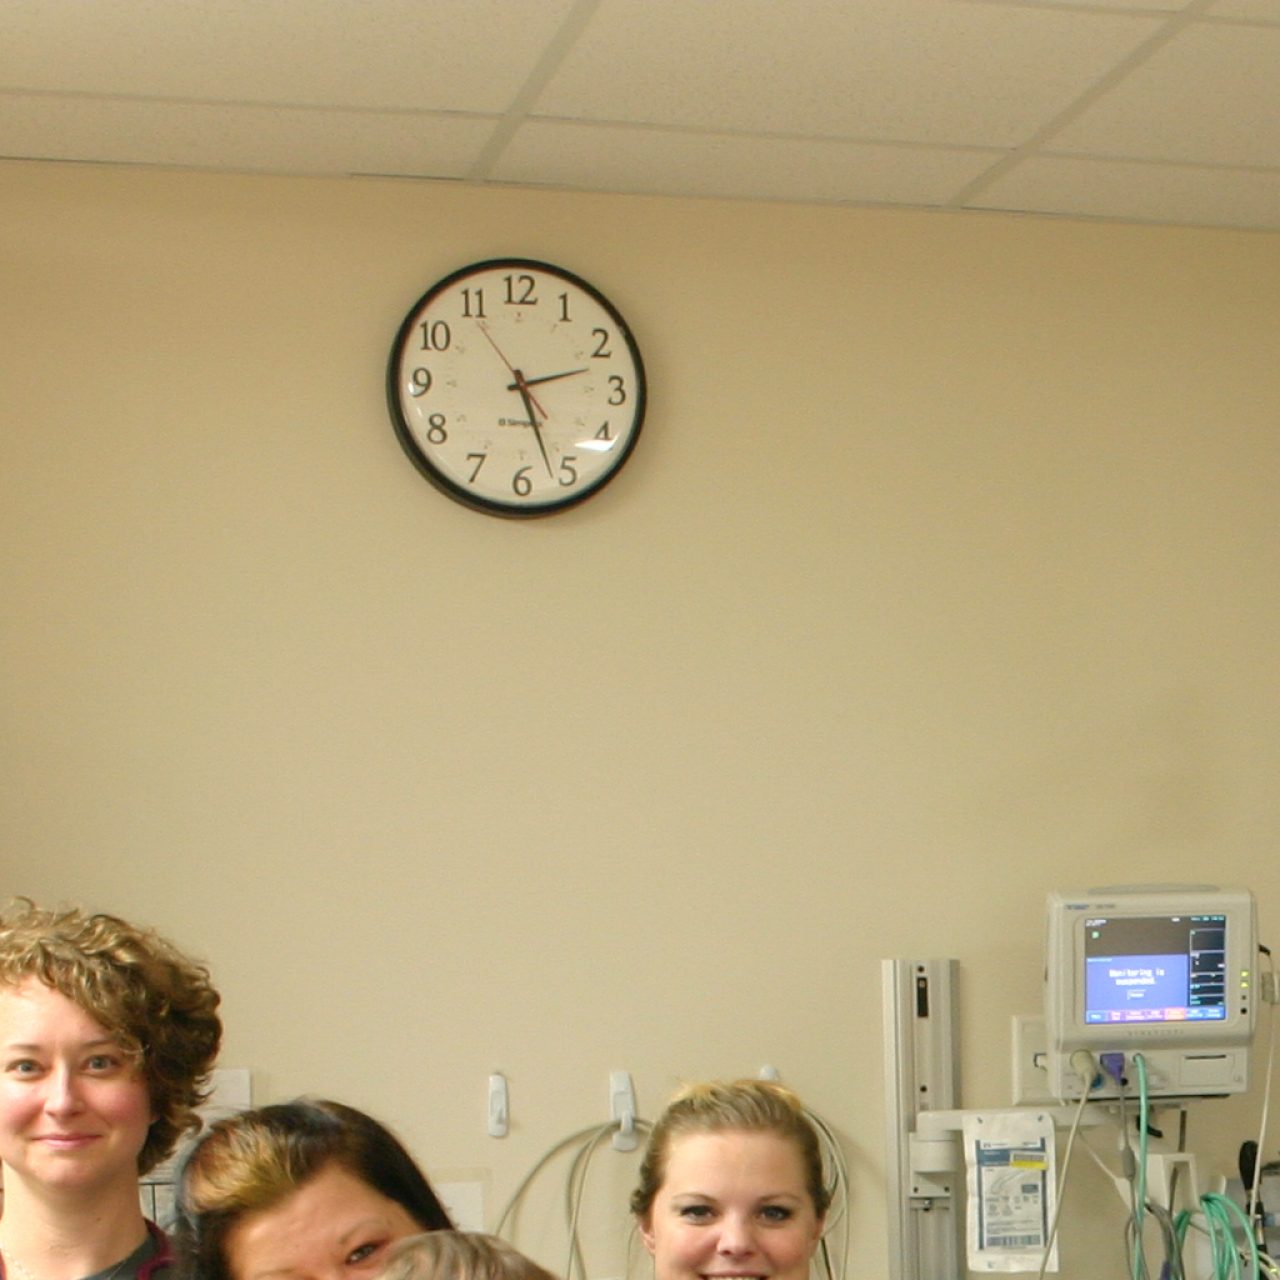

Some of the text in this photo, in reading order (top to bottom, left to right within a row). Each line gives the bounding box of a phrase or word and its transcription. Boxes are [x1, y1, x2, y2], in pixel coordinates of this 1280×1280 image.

[461, 288, 487, 318] 11
[503, 275, 538, 305] 12
[558, 293, 572, 322] 1
[420, 320, 451, 351] 10
[591, 328, 612, 358] 2
[412, 367, 432, 397] 9
[608, 375, 626, 405] 3
[426, 413, 448, 444] 8
[594, 421, 612, 444] 4
[466, 454, 487, 483] 7
[512, 466, 533, 497] 6
[559, 456, 578, 486] 5
[1109, 968, 1165, 978] Monitoring is
